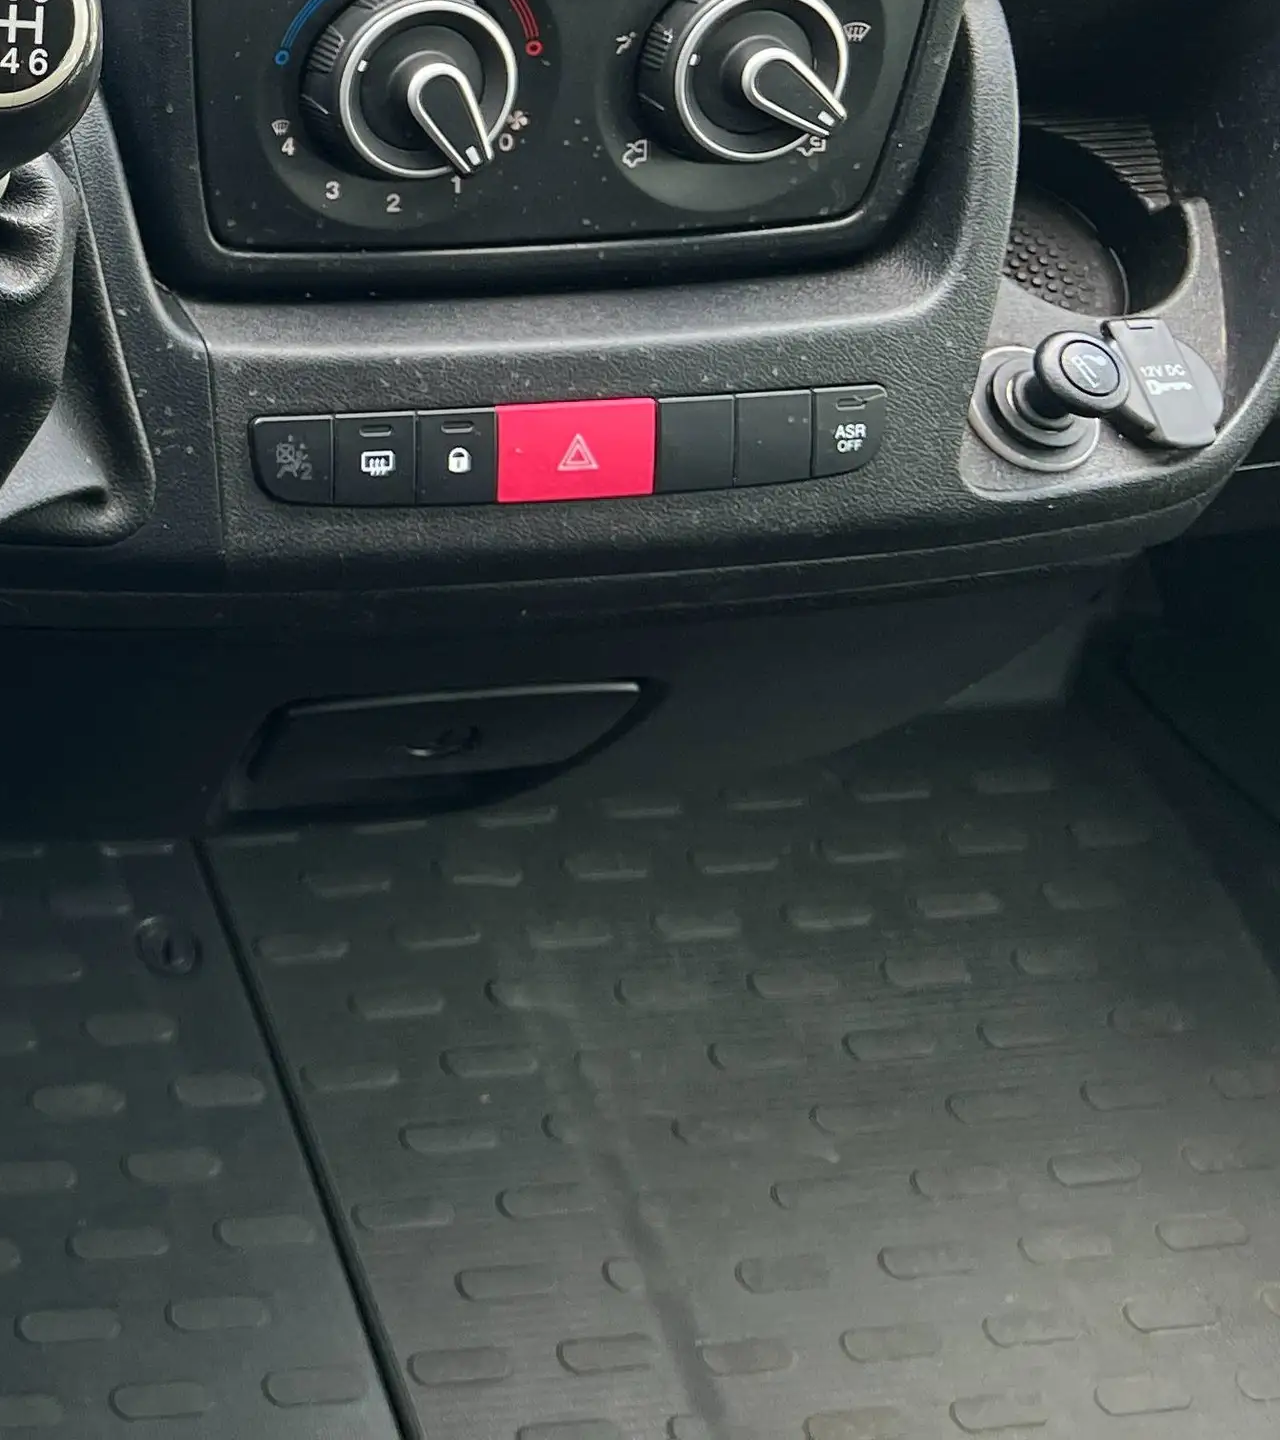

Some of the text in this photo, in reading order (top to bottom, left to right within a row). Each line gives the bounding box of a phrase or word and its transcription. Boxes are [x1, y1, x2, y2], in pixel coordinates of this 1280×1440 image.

[0, 47, 19, 73] 4
[28, 48, 48, 75] 6
[281, 137, 295, 155] 4
[498, 133, 513, 151] 0
[325, 181, 339, 199] 3
[450, 175, 461, 193] 1
[386, 193, 401, 211] 2
[1164, 363, 1185, 376] DC
[834, 423, 866, 439] ASR
[836, 439, 863, 453] OFF
